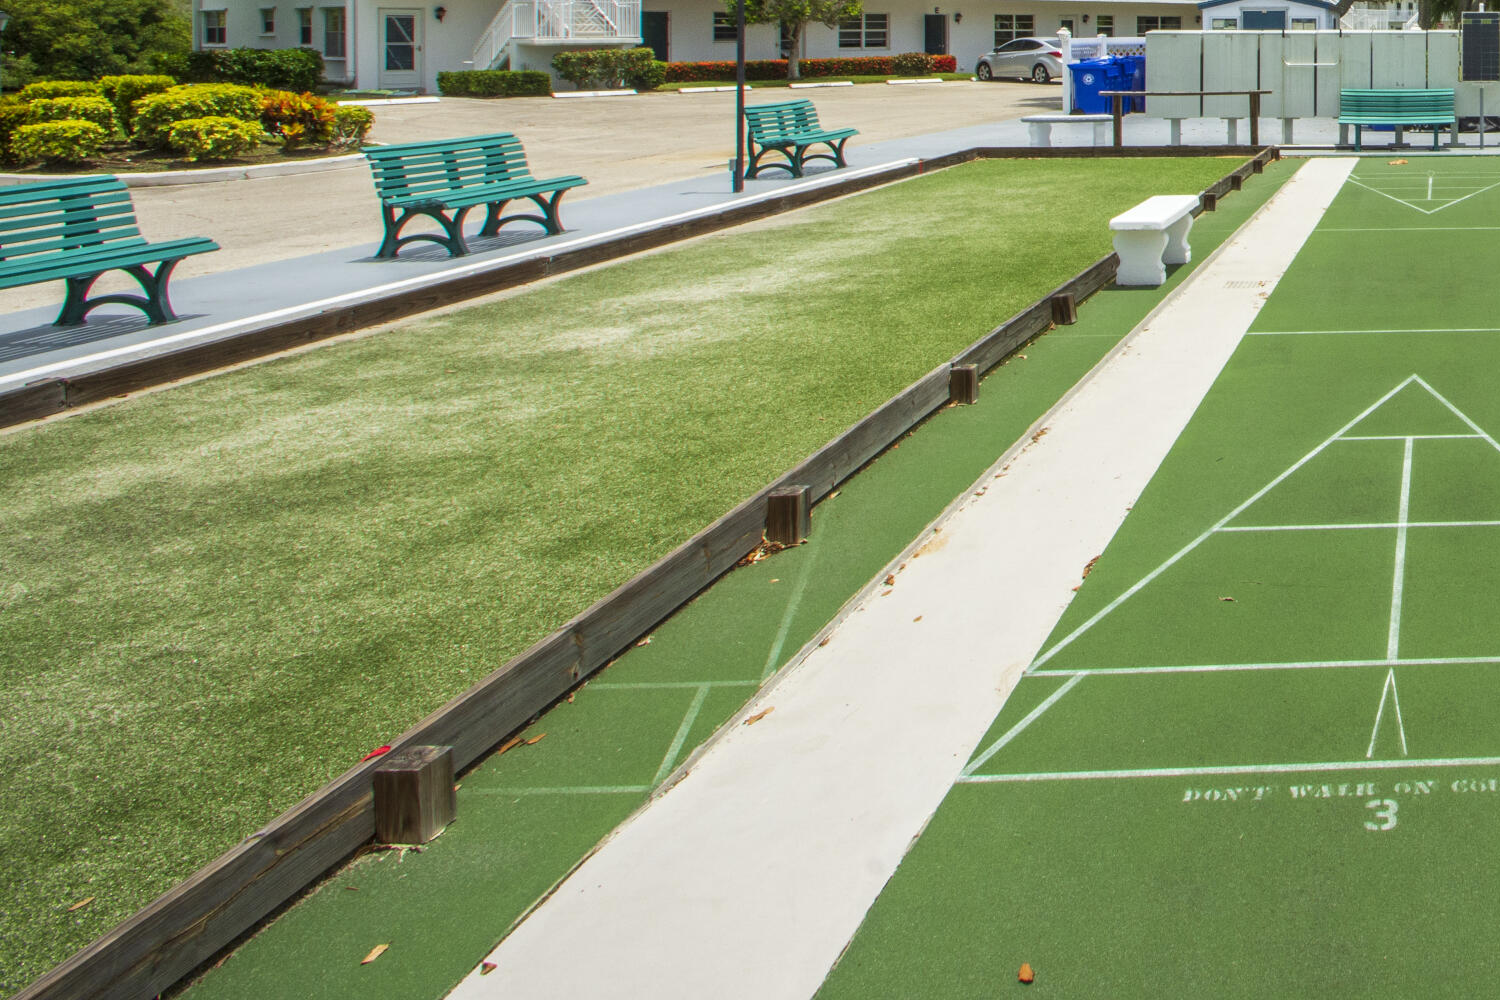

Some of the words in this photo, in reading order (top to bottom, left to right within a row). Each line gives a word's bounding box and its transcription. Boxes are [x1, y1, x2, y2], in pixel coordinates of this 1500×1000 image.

[1290, 782, 1375, 798] WALK
[1394, 779, 1435, 795] ON
[1364, 799, 1399, 831] 3
